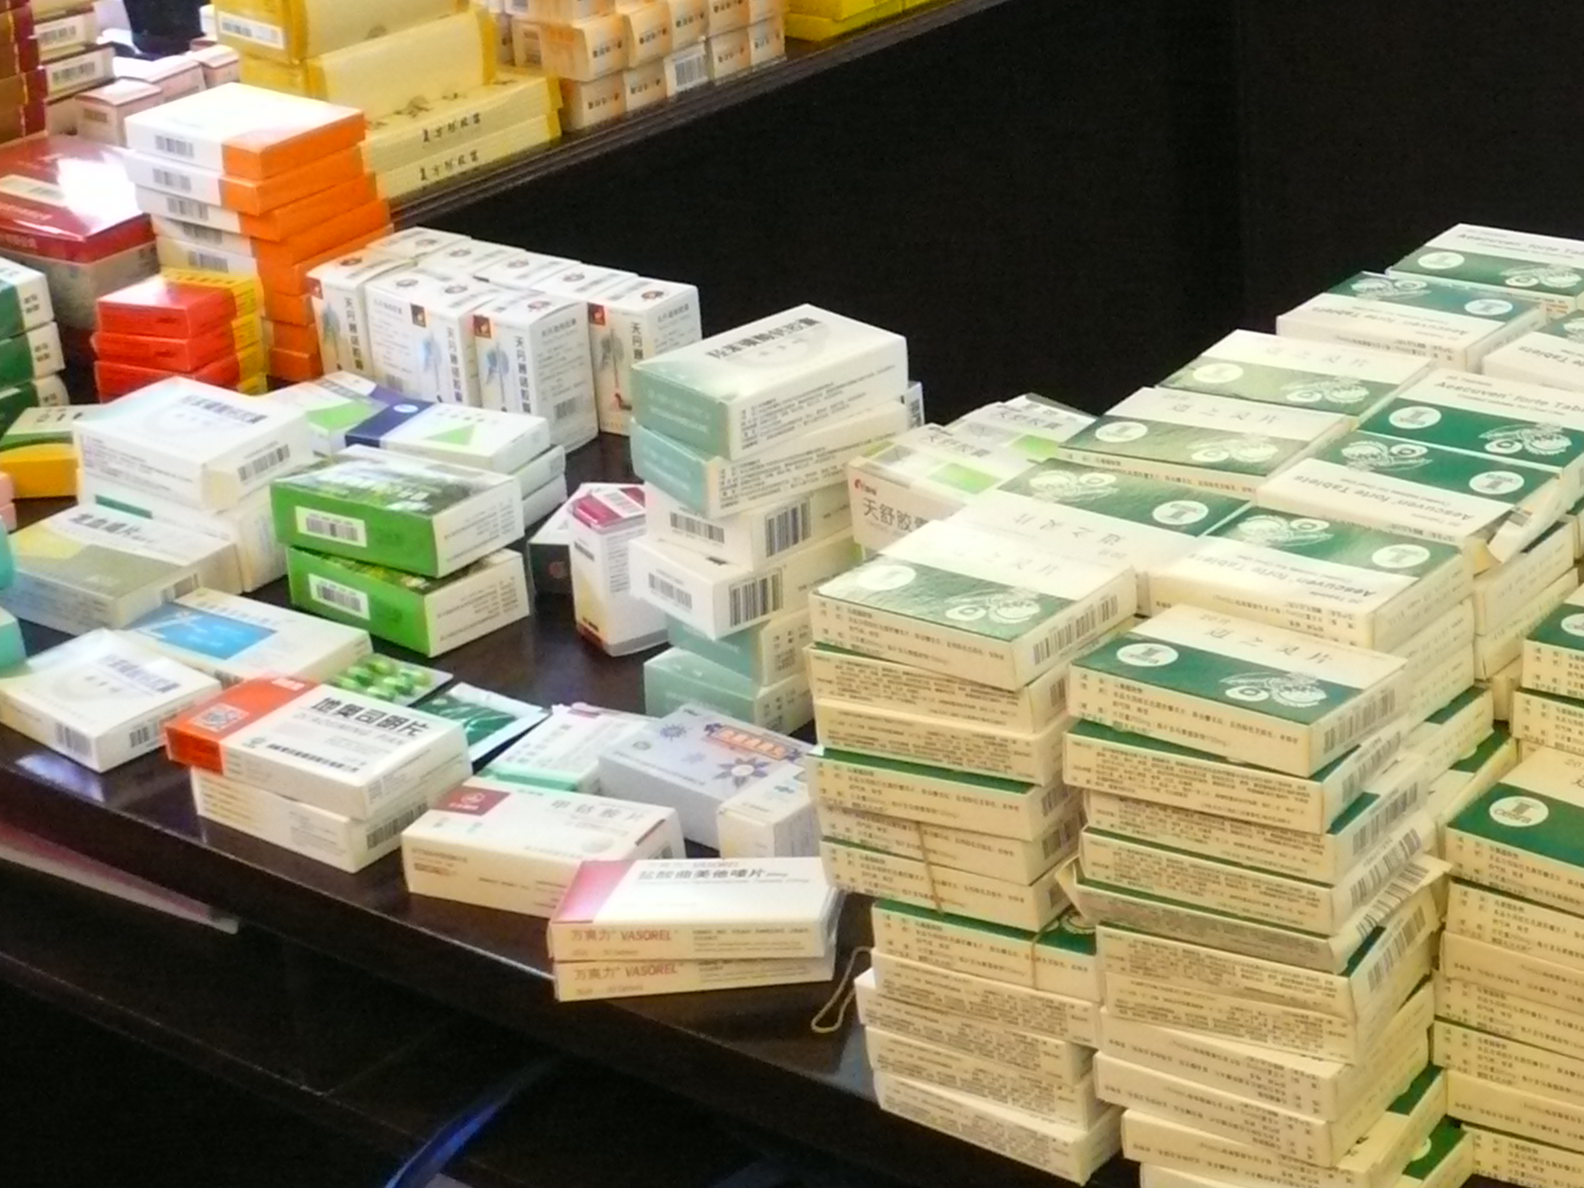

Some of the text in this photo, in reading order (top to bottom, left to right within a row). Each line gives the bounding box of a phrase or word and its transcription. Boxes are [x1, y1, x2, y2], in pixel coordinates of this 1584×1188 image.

[310, 696, 430, 736] 地奥司明片
[638, 868, 765, 880] 盐酸曲美他嗪片
[621, 930, 672, 942] VASOREL
[626, 964, 678, 978] VASOREL
